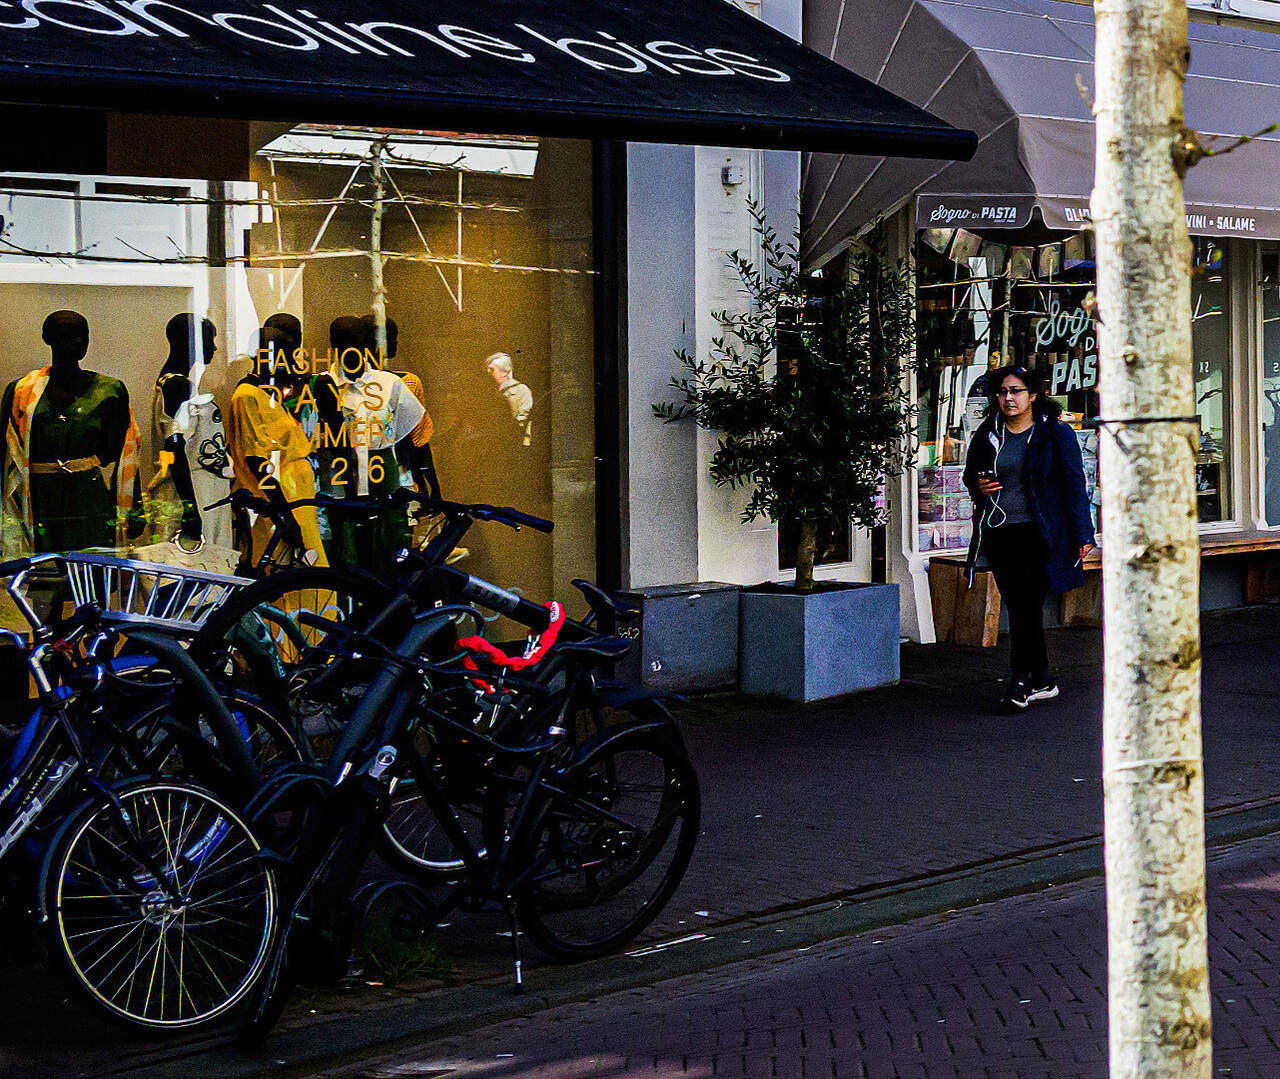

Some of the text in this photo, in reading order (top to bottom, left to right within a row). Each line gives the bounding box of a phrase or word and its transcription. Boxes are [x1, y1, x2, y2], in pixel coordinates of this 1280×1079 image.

[515, 23, 791, 83] biss
[930, 203, 971, 223] Sogno
[981, 206, 1017, 220] PASTA
[1185, 214, 1255, 232] VINI SALAME
[1035, 300, 1097, 352] Sog
[256, 347, 384, 375] FASHION
[1051, 354, 1097, 396] PAS
[258, 381, 384, 414] DAYS
[258, 455, 385, 490] 226
